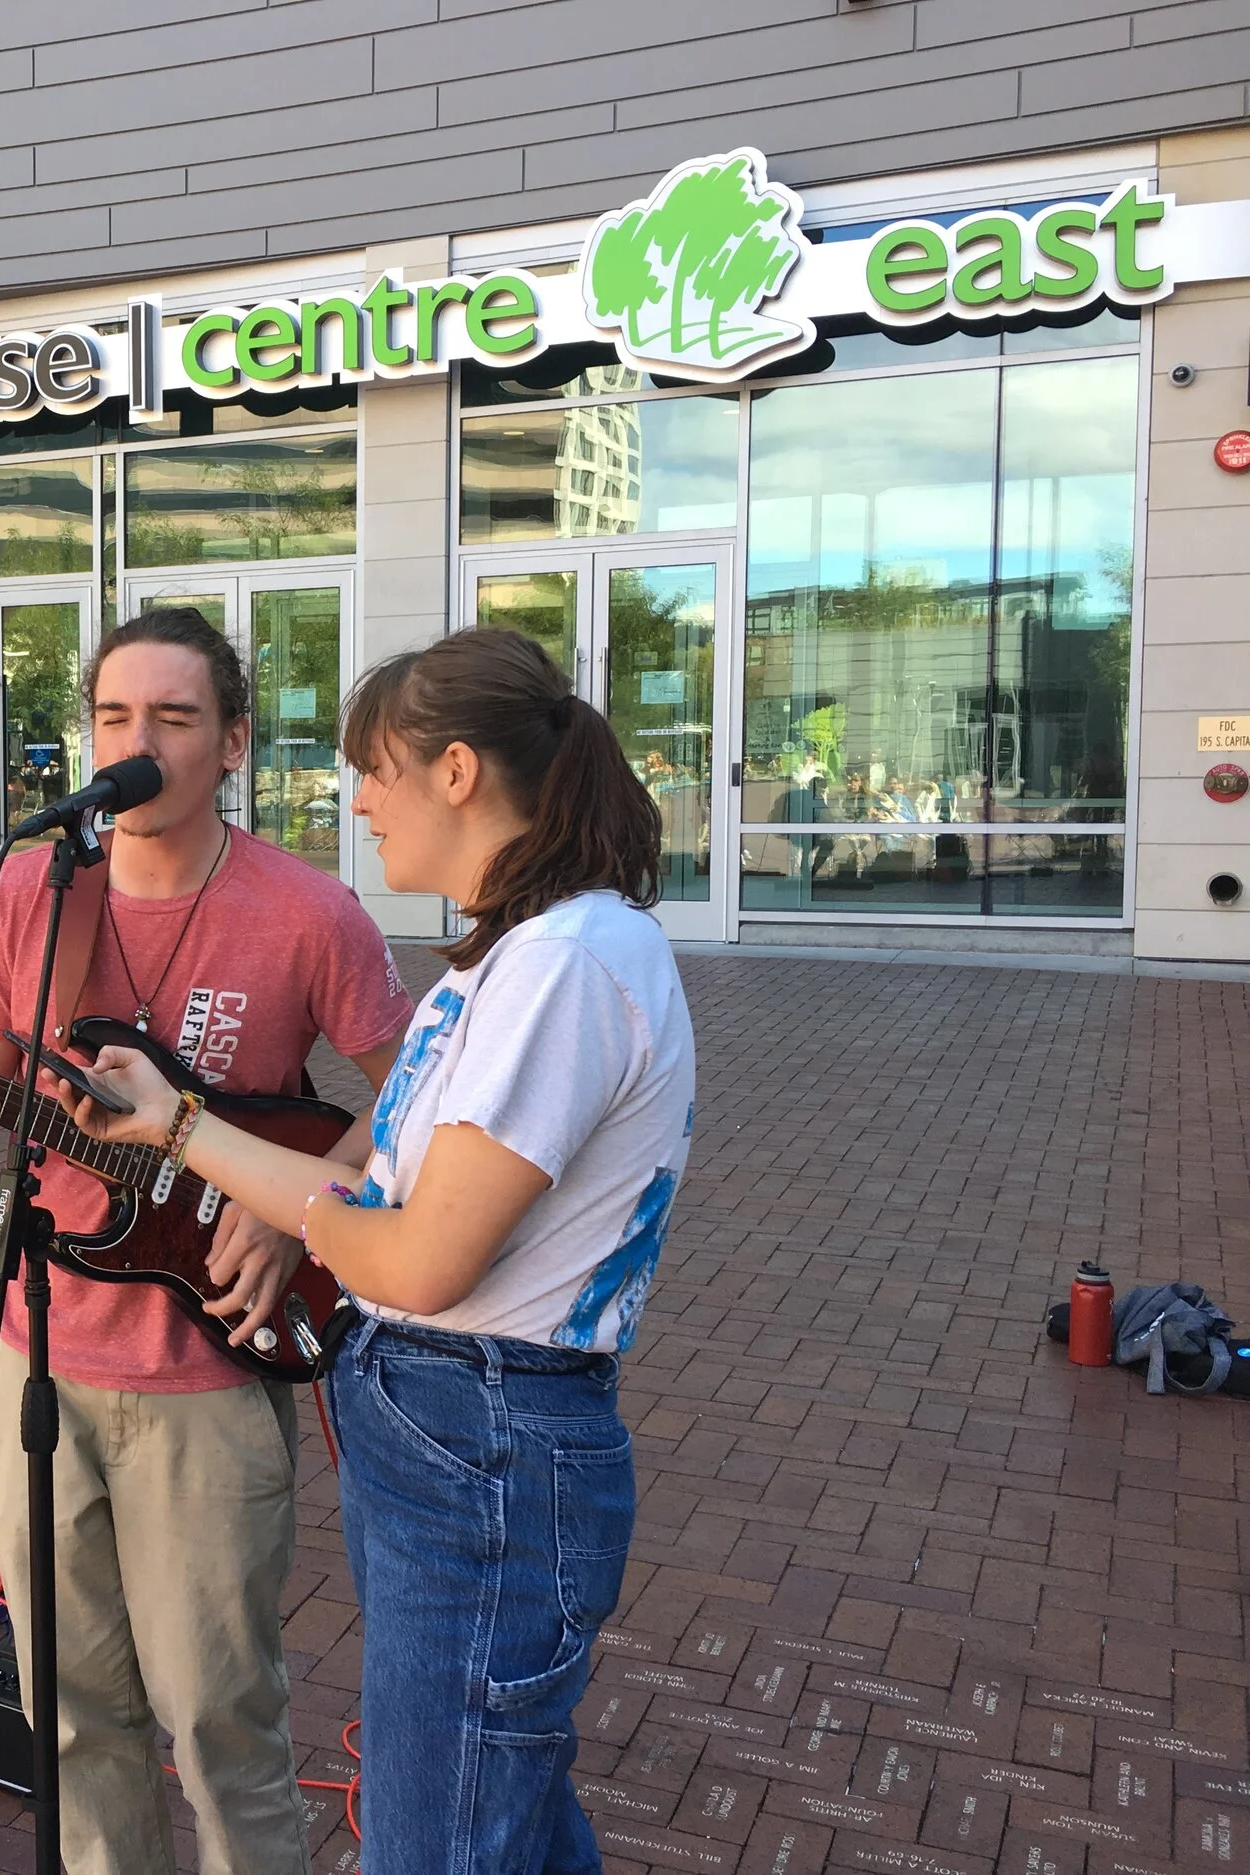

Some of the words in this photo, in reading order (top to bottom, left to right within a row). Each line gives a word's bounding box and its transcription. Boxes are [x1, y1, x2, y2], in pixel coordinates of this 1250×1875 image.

[181, 274, 538, 388] centre
[866, 184, 1165, 314] east
[1219, 721, 1236, 731] FDC
[1200, 737, 1212, 747] 195
[1216, 736, 1223, 747] S.
[1212, 765, 1228, 773] AUTO
[197, 991, 247, 1085] CASCA
[599, 1638, 629, 1646] GARY
[633, 1643, 651, 1651] THE
[773, 1639, 821, 1652] SEREDUK
[837, 1651, 864, 1660] PAUL
[855, 1679, 899, 1692] TURNER
[714, 1721, 740, 1729] AND
[745, 1726, 764, 1735] JOE
[906, 1717, 976, 1736] WATERMAN
[915, 1727, 978, 1743] LAURENCE
[1155, 1742, 1183, 1751] AND
[735, 1751, 779, 1765] GOLLER
[1189, 1748, 1227, 1760] KEVIN
[799, 1765, 818, 1775] JIM
[990, 1768, 1036, 1782] KINDER
[981, 1774, 1002, 1782] IDA
[583, 1783, 627, 1797] MOORE
[1019, 1780, 1045, 1791] KEN
[1205, 1781, 1232, 1792] EVIE
[607, 1796, 658, 1812] MICHAEL
[800, 1796, 883, 1818] FOUNDATION
[808, 1805, 872, 1823] ARHRITIS
[1042, 1818, 1072, 1830] TOM
[1091, 1827, 1136, 1842] SUSAN
[1060, 1815, 1120, 1832] MUNSON
[604, 1831, 691, 1857] STUEKEMANN
[698, 1852, 722, 1863] BILL
[855, 1850, 901, 1866] MILLER
[1028, 1847, 1041, 1869] SAYERS
